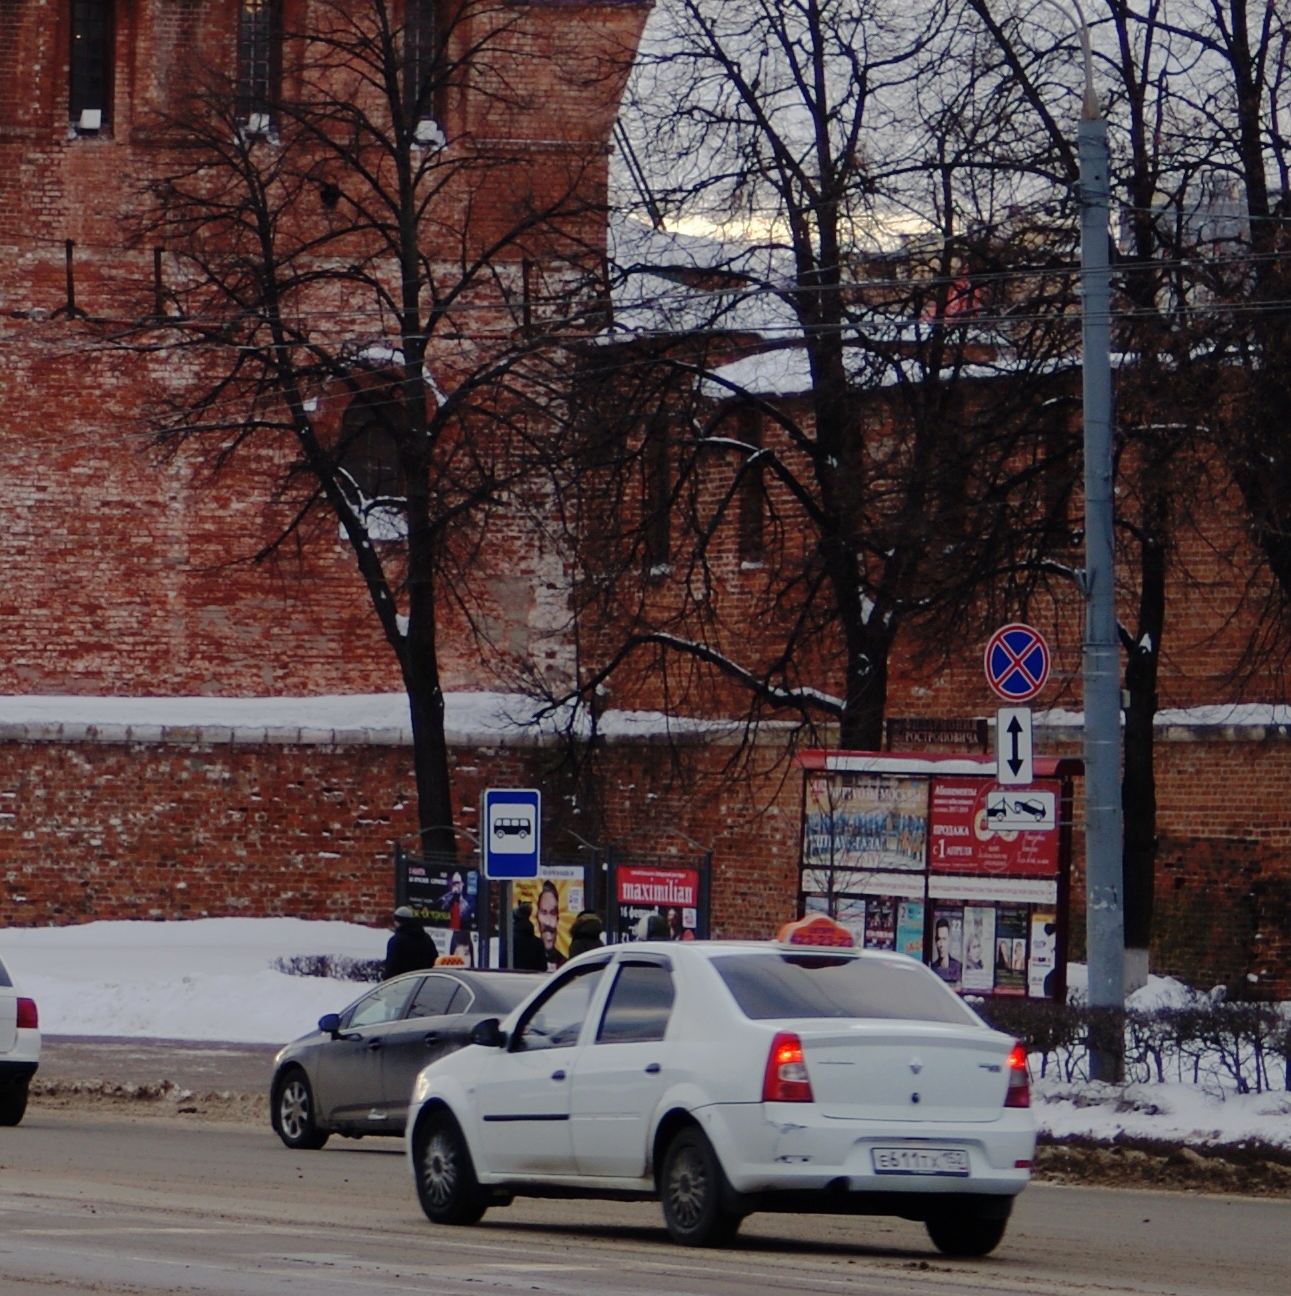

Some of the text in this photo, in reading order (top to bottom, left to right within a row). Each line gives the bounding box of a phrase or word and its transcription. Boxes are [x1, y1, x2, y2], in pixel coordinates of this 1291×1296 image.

[905, 732, 978, 743] РОСТРОПОВИЧА
[933, 824, 970, 836] ПРОДАЖА
[938, 838, 945, 859] 1
[946, 846, 973, 856] АПРЕЛЯ
[622, 877, 693, 904] maximilian
